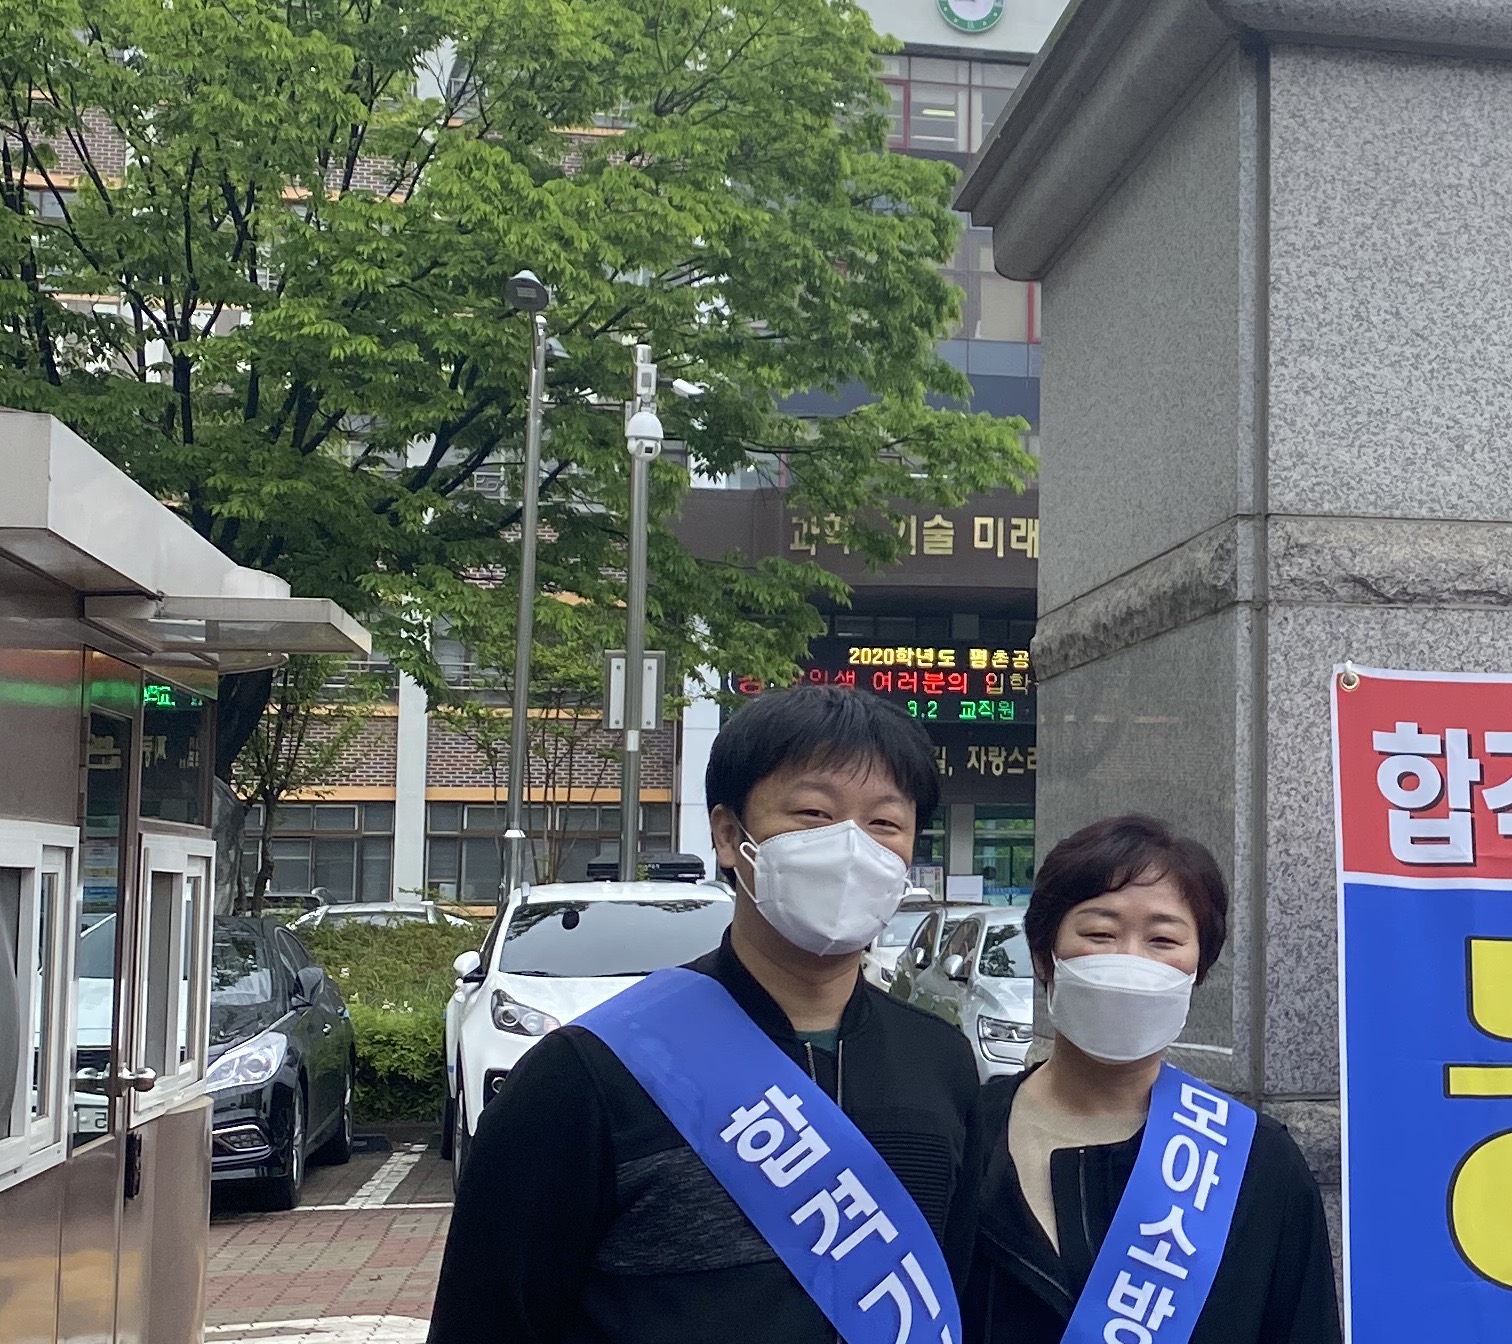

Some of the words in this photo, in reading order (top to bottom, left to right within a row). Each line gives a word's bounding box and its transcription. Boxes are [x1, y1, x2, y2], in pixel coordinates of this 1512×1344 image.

[973, 514, 1040, 559] 미래
[848, 646, 956, 668] 2020학년도
[872, 670, 969, 694] 여러분의
[958, 700, 1015, 721] 교직원
